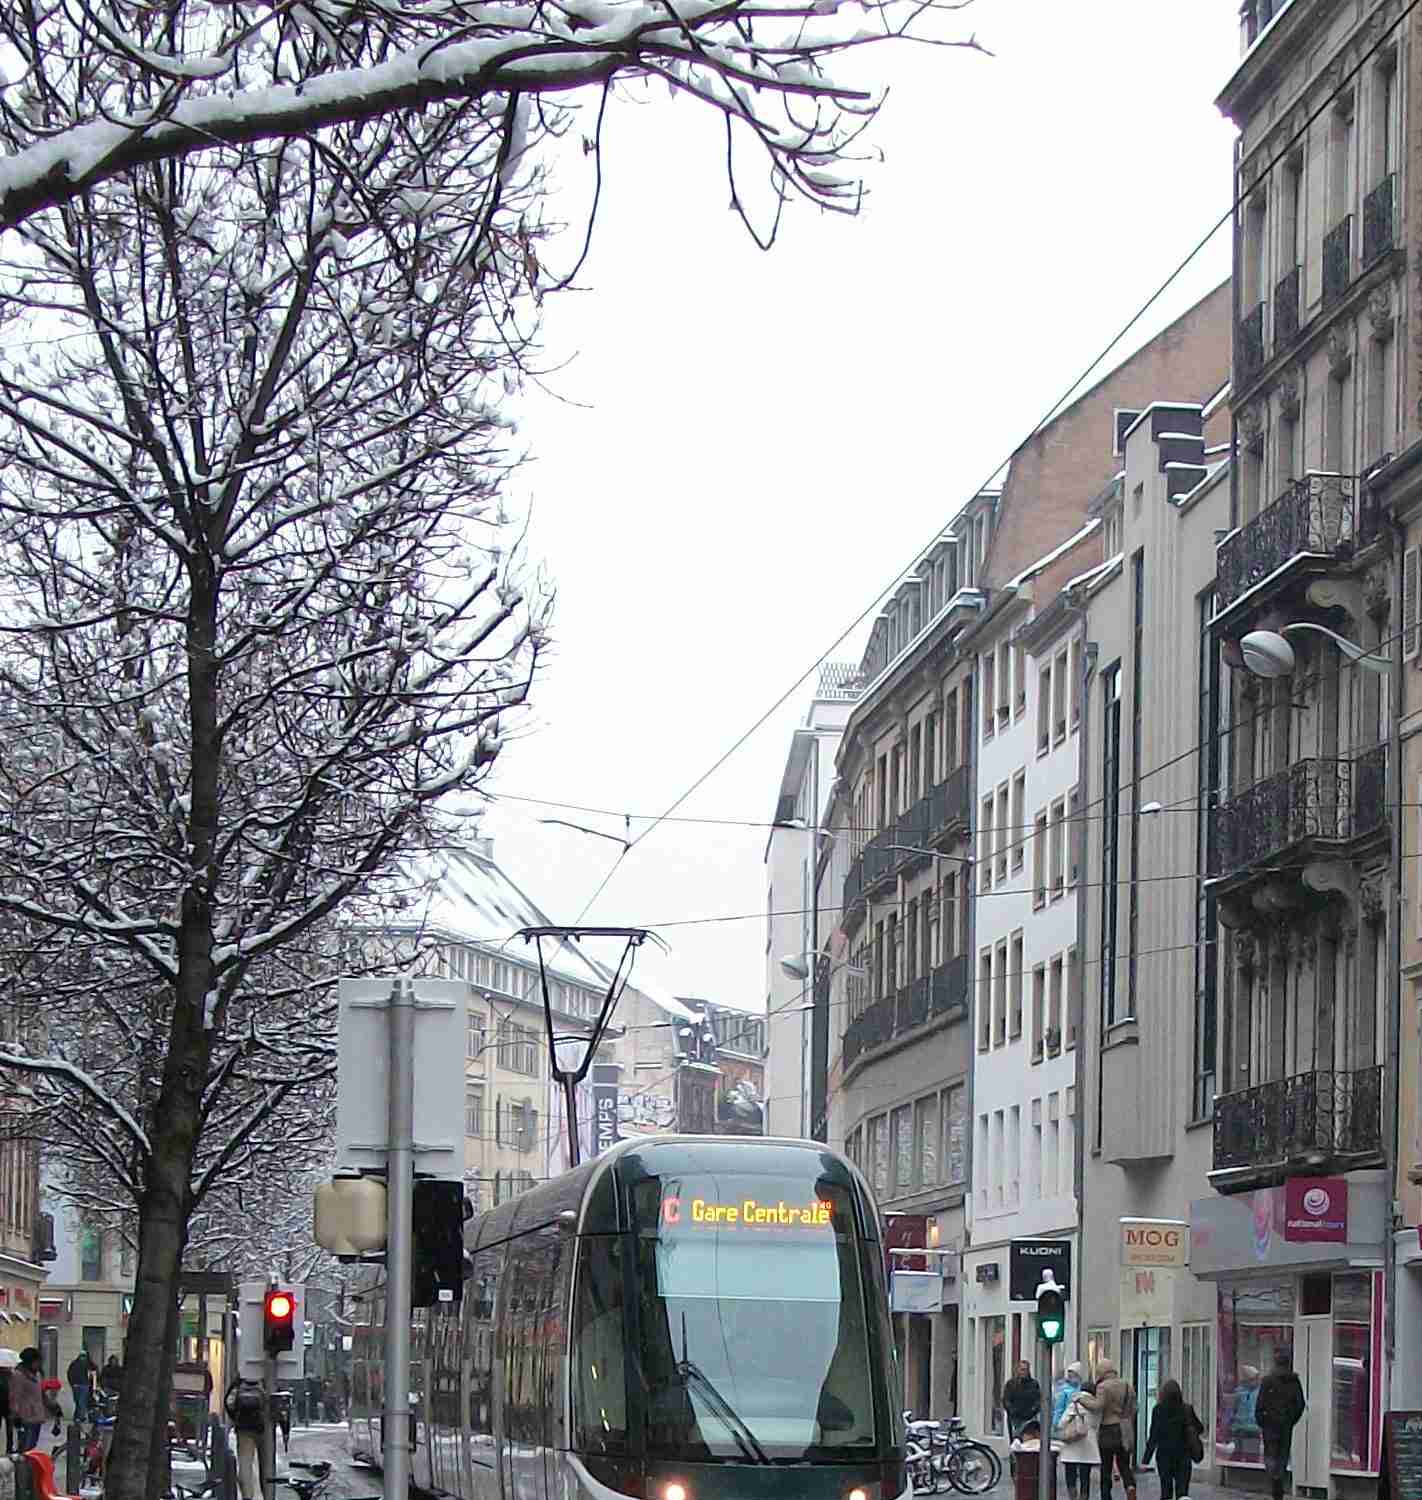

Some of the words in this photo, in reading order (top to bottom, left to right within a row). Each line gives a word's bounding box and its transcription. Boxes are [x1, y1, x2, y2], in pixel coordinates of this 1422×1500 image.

[663, 1198, 681, 1223] C
[692, 1199, 738, 1222] Gare
[743, 1200, 831, 1225] Centrale
[1127, 1230, 1179, 1247] MOG
[1019, 1246, 1064, 1256] KUONI
